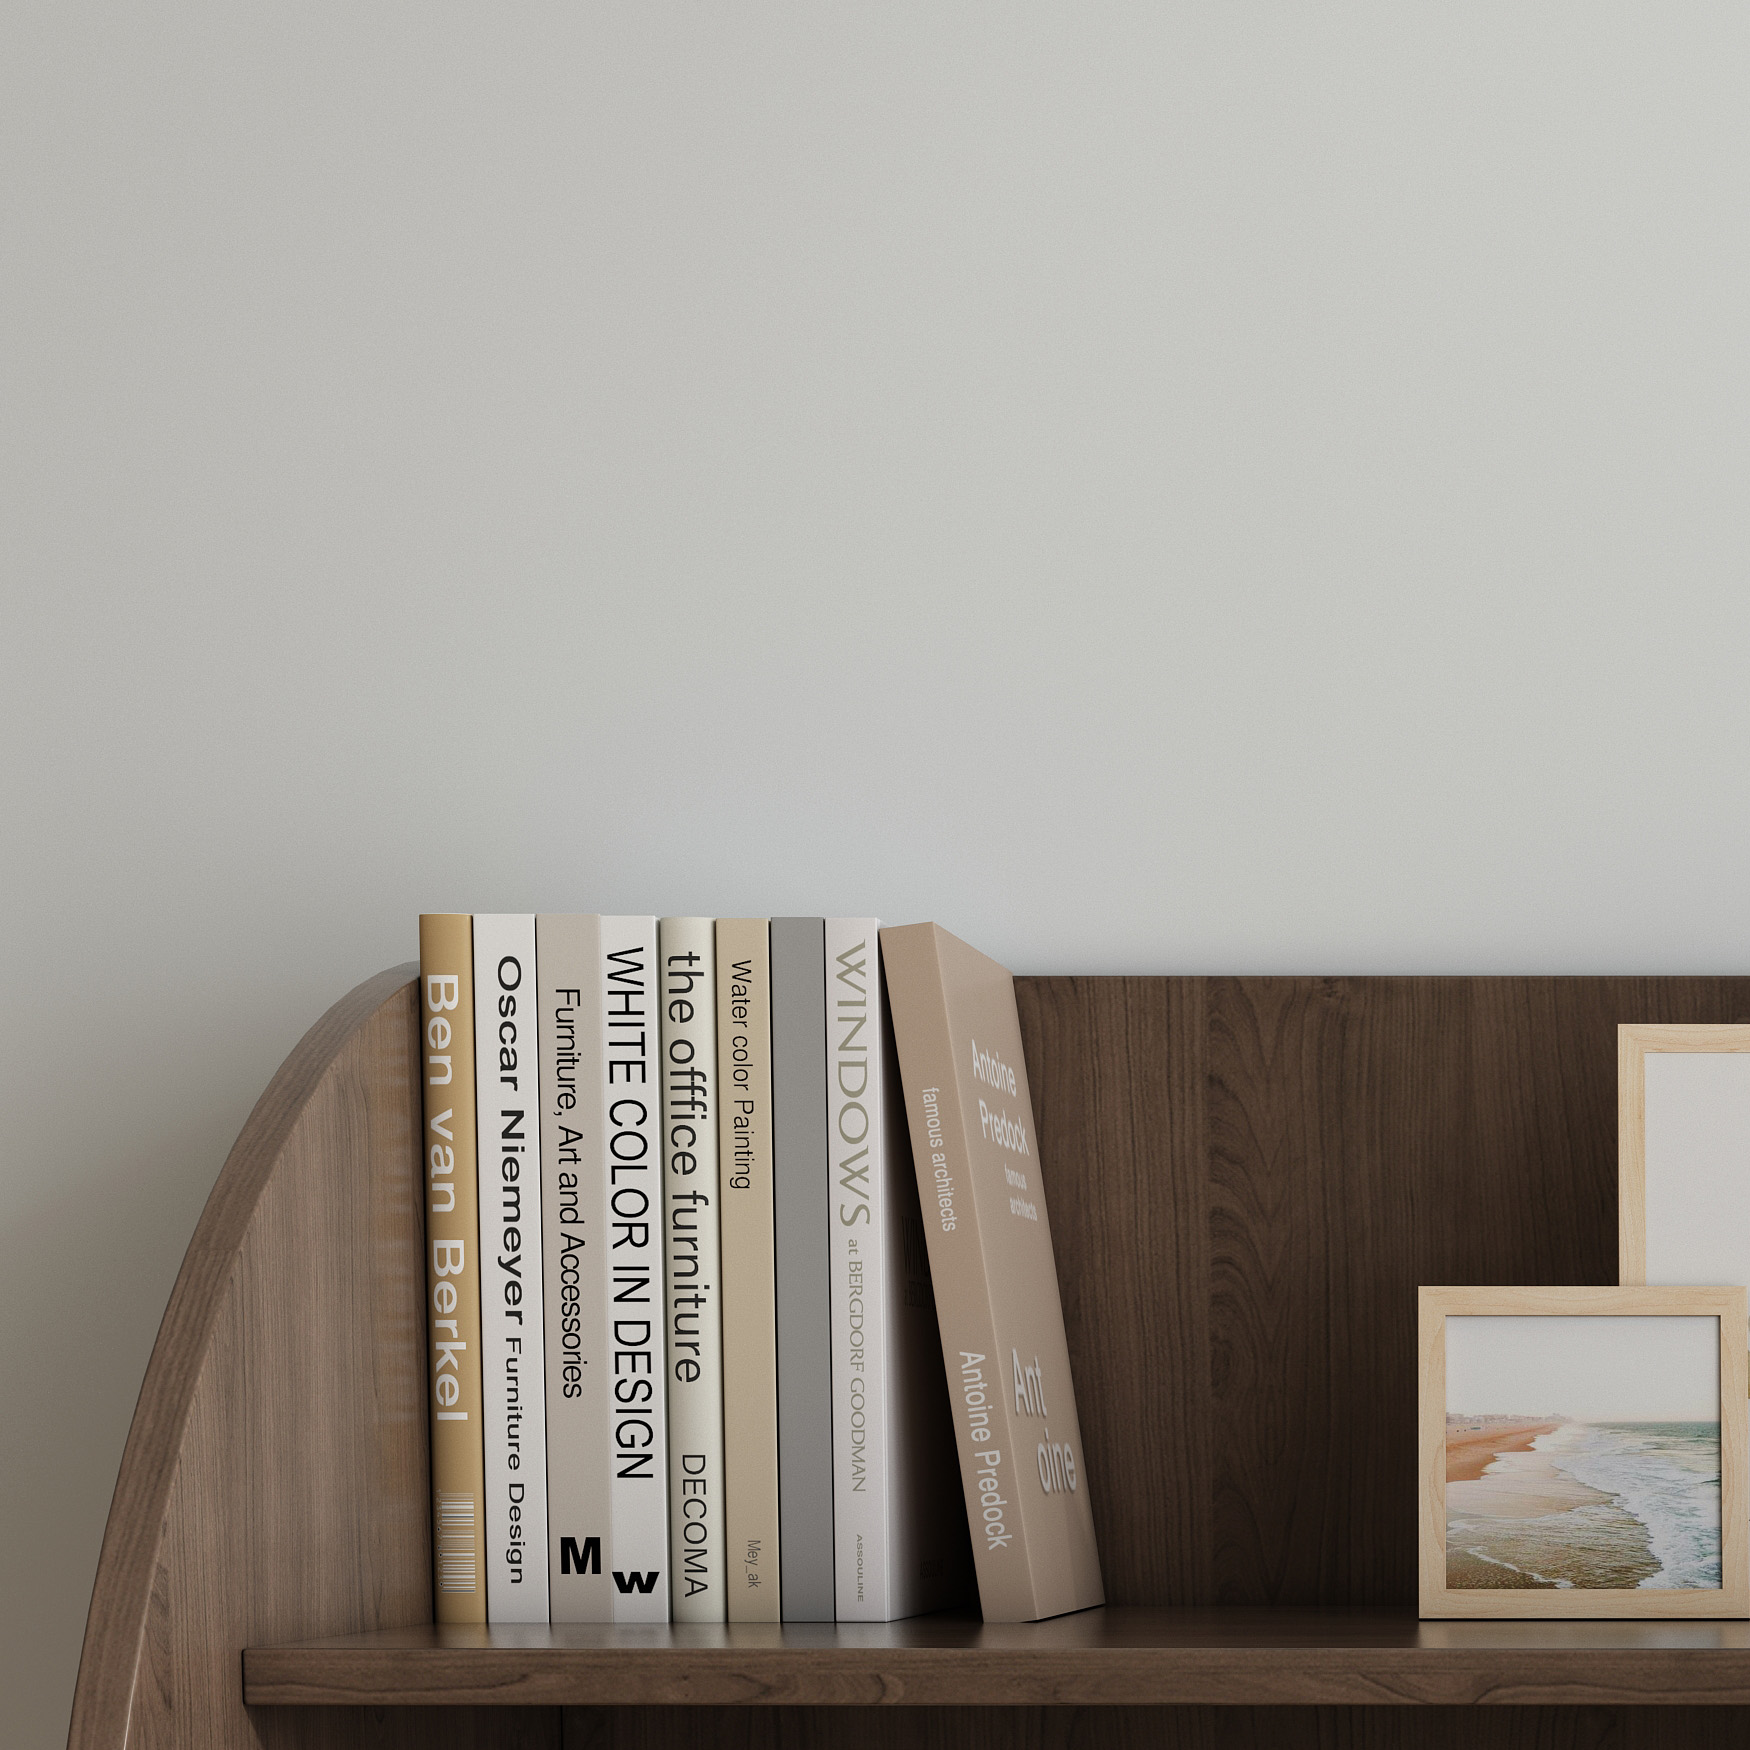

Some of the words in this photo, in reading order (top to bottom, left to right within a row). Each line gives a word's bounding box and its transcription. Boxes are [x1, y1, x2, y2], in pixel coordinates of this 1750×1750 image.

[427, 975, 458, 1085] Ben
[498, 956, 521, 1091] Oscar
[607, 947, 646, 1084] WHITE
[668, 951, 704, 1023] the
[731, 960, 752, 1027] Water
[553, 989, 582, 1115] Furniture,
[732, 1036, 753, 1090] color
[836, 939, 870, 1226] WINDOWS
[972, 1038, 1017, 1097] Antoine
[429, 1109, 455, 1212] van
[558, 1126, 583, 1164] Art
[729, 1101, 755, 1189] Painting
[922, 1086, 943, 1147] famous
[979, 1098, 1030, 1156] Predock
[498, 1110, 525, 1325] Niemeyer
[558, 1172, 584, 1223] and
[609, 1099, 649, 1249] COLOR
[931, 1152, 958, 1232] architects
[613, 1266, 650, 1302] IN
[672, 1190, 710, 1382] furniture
[848, 1239, 858, 1255] at
[432, 1239, 468, 1420] Berkel
[560, 1232, 588, 1398] Accessories
[849, 1261, 865, 1372] BERGDORF
[505, 1337, 522, 1470] Furniture
[614, 1320, 653, 1479] DESIGN
[959, 1351, 994, 1442] Antoine
[1012, 1347, 1047, 1417] Ant
[850, 1378, 866, 1492] GOODMAN
[505, 1483, 525, 1584] Design
[682, 1454, 709, 1598] DECOMA
[975, 1449, 1013, 1551] Predock
[560, 1537, 601, 1575] M
[856, 1534, 864, 1603] ASSOULINE
